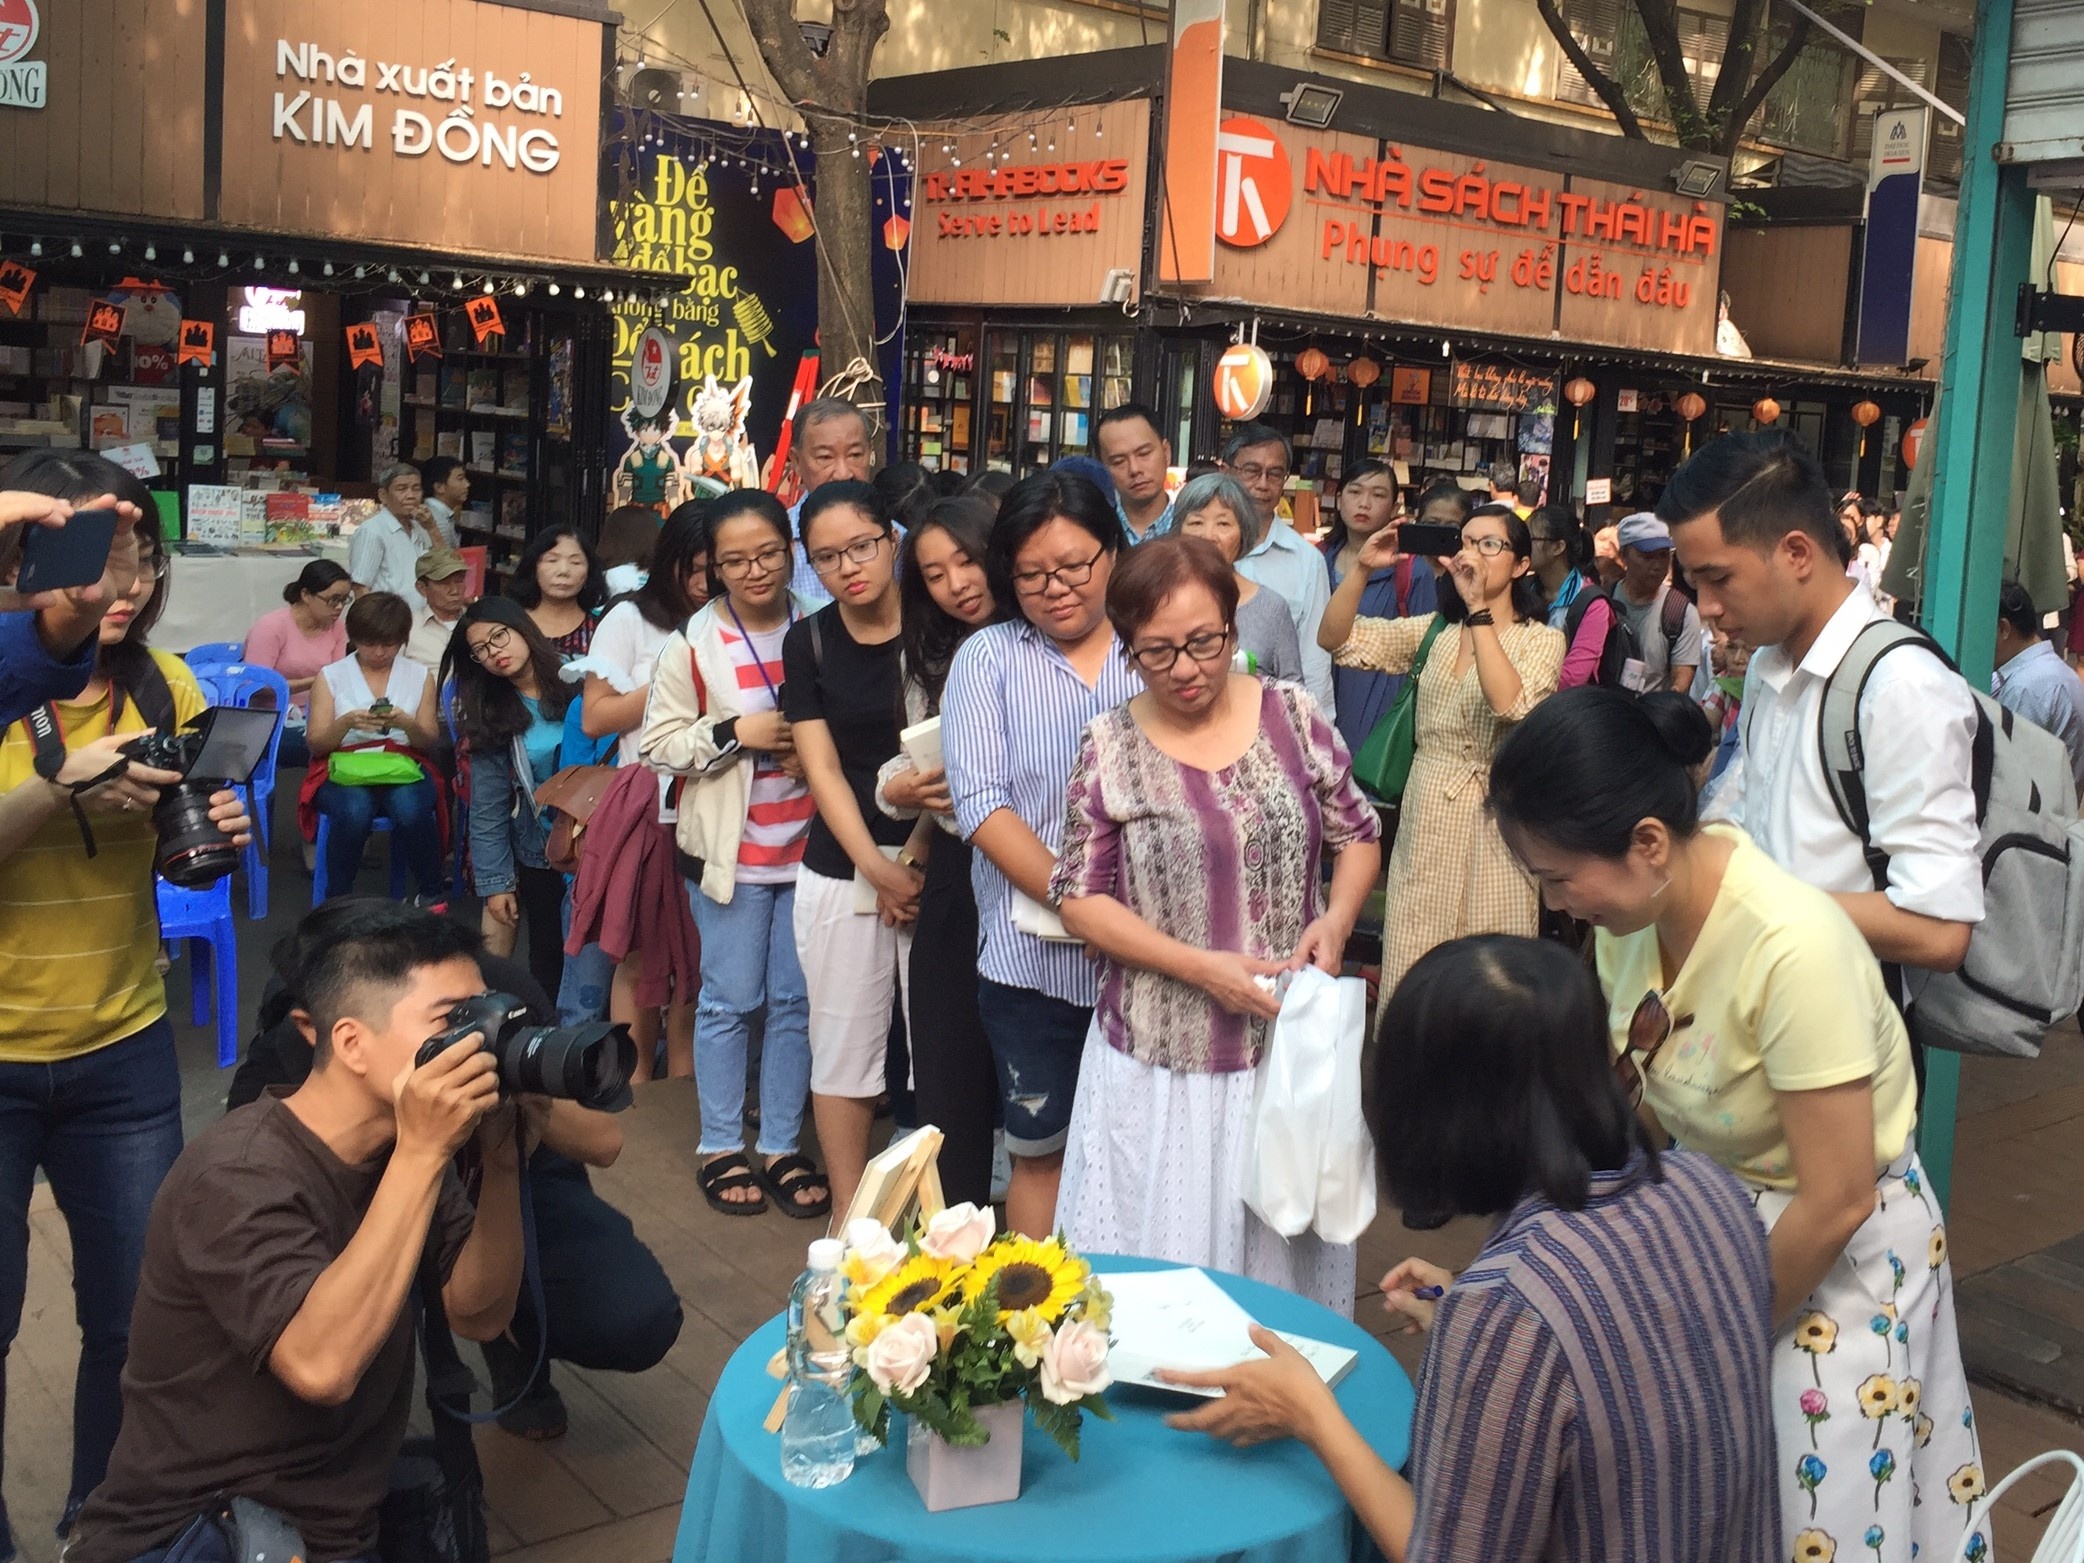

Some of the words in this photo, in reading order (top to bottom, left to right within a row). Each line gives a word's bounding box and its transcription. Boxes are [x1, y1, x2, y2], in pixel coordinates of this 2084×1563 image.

[276, 38, 366, 87] Nhà
[375, 56, 475, 102] xuất
[484, 70, 563, 117] bản
[273, 90, 373, 149] KIM
[391, 103, 560, 173] ĐỒNG
[654, 153, 710, 210] Để
[1304, 145, 1413, 208] NHÀ
[1417, 161, 1551, 230] SÁCH
[1556, 190, 1655, 246] THÁI
[1659, 200, 1717, 256] HÀ
[938, 209, 1002, 239] Serve
[1008, 207, 1034, 237] to
[1038, 201, 1101, 236] Lead
[674, 246, 738, 305] bạc
[1321, 219, 1440, 285] Phụng
[1458, 248, 1499, 294] sự
[1510, 243, 1557, 291] để
[672, 296, 720, 328] bằng
[30, 705, 52, 738] non
